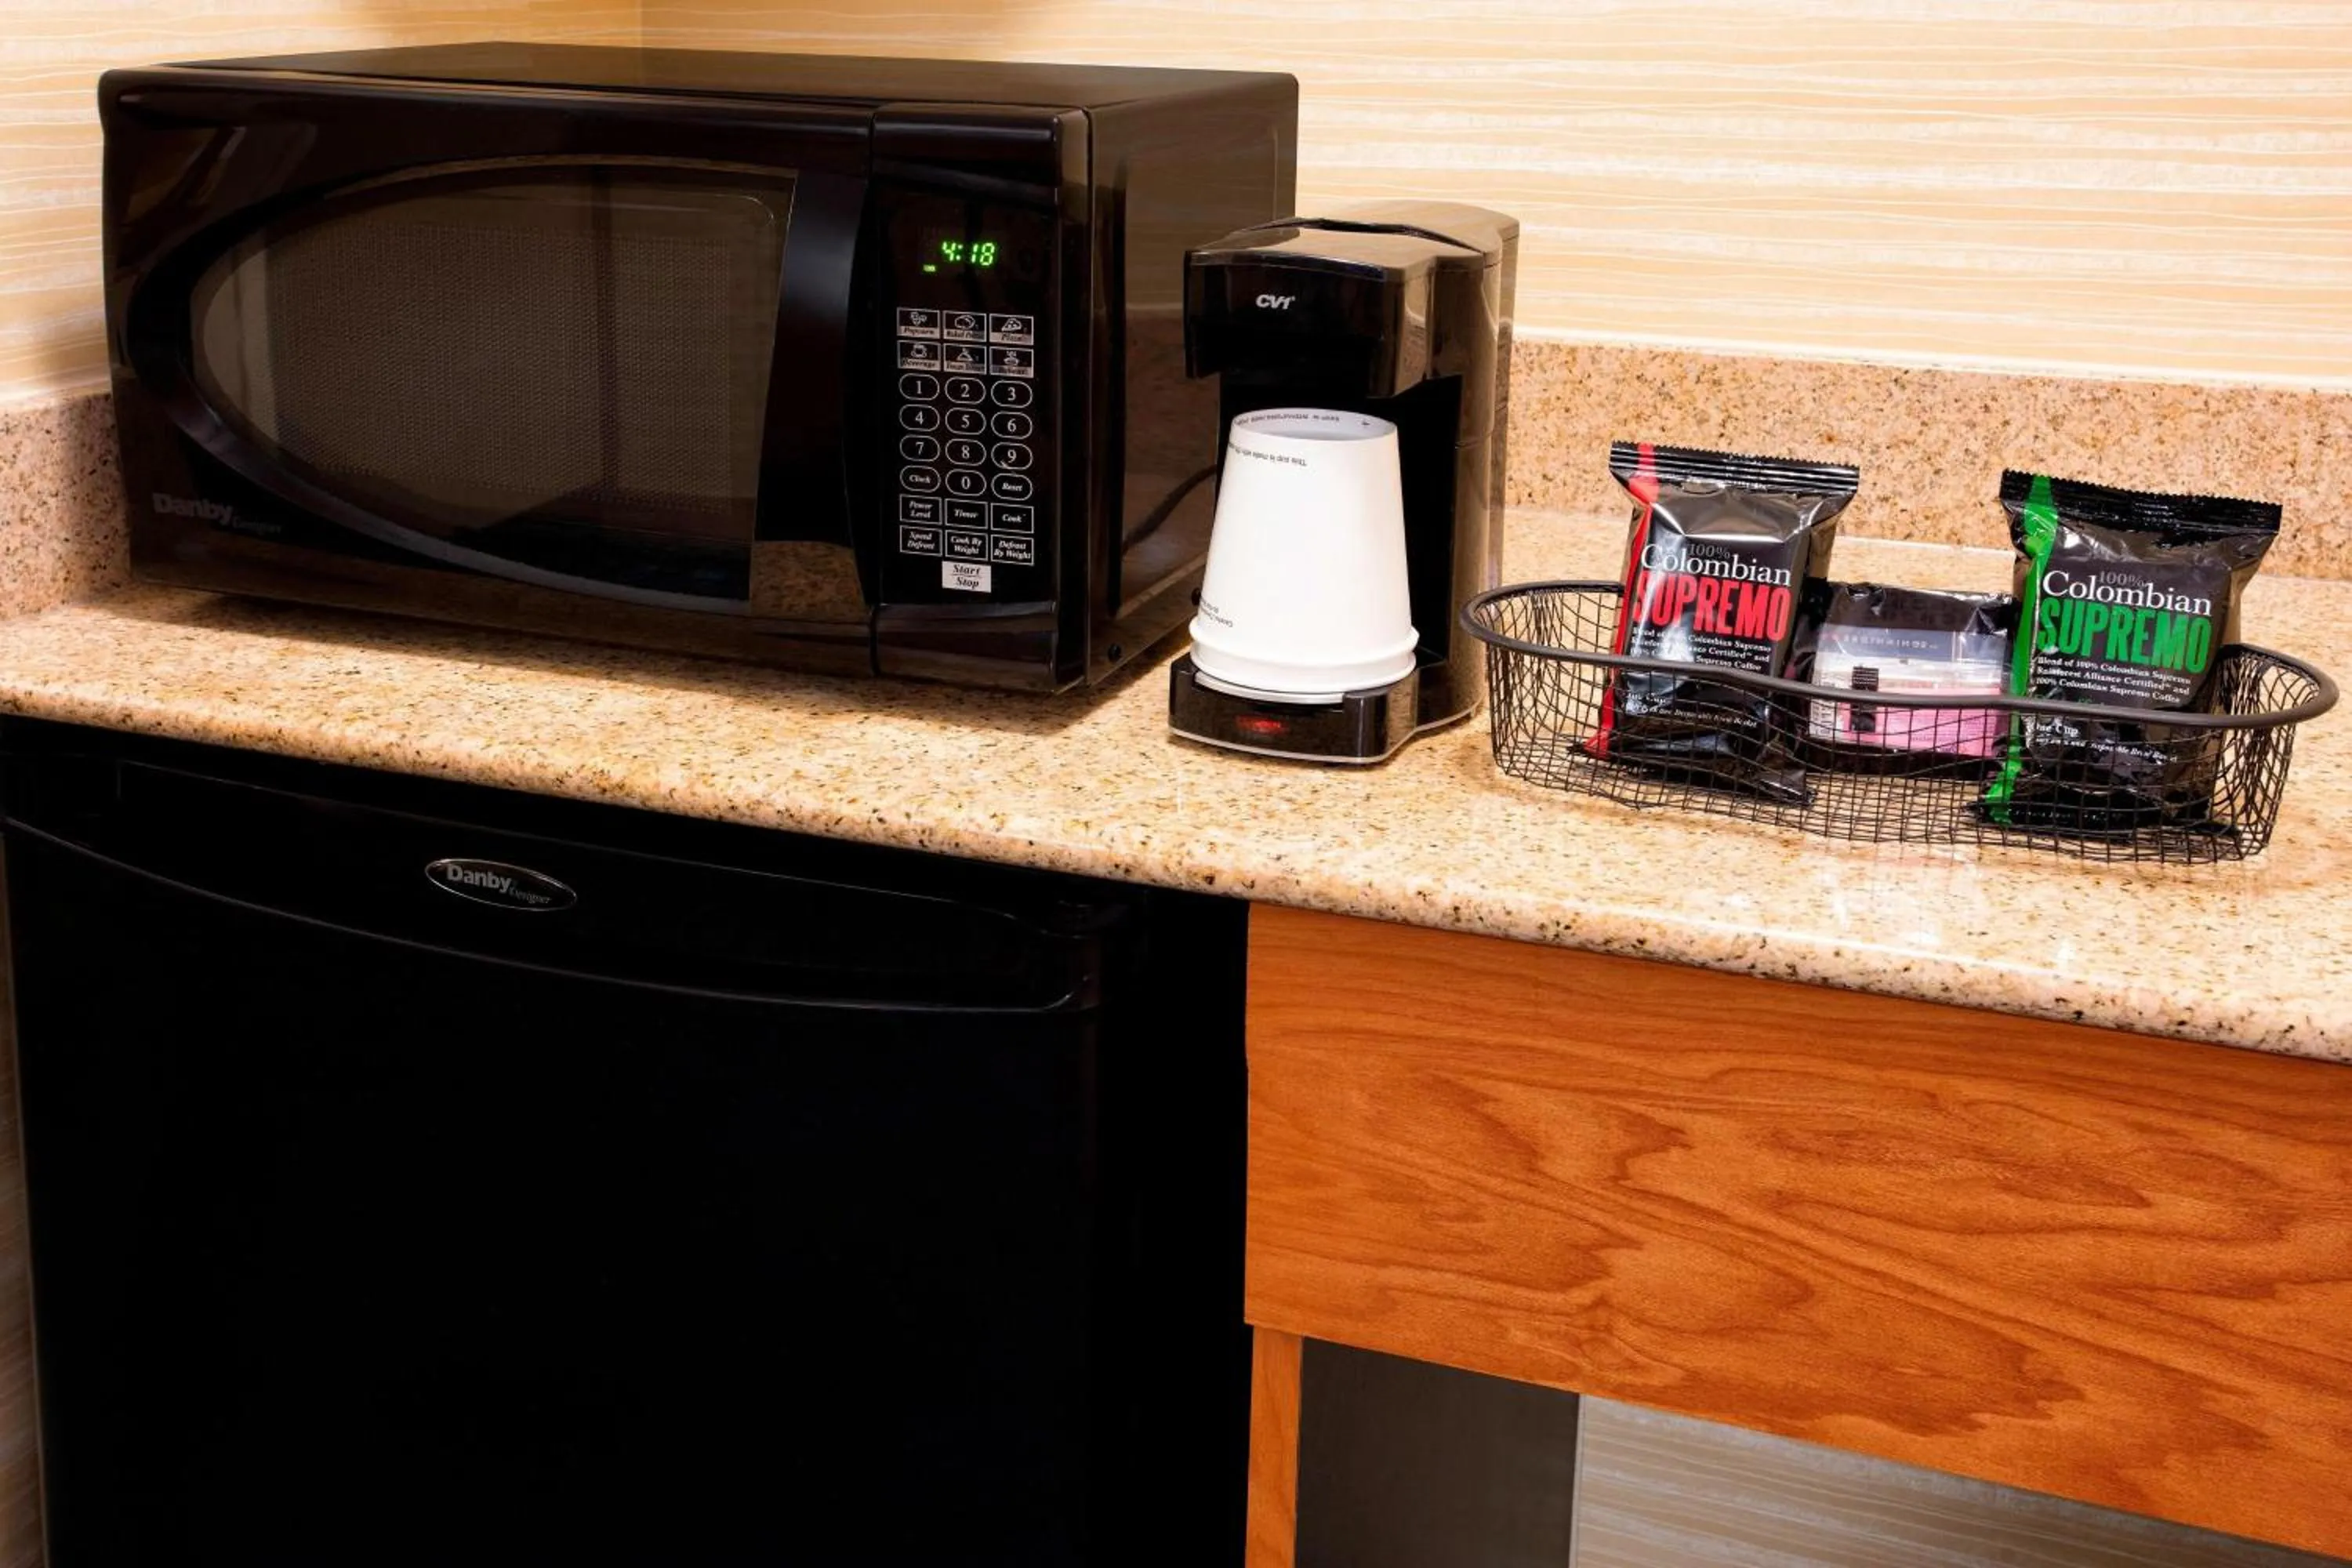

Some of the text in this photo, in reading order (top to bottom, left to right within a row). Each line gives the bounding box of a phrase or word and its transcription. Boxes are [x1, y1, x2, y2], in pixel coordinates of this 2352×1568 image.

[942, 241, 995, 266] 4:18
[916, 380, 1017, 401] 1 2 3
[915, 411, 1017, 432] 4 5 6
[915, 441, 1017, 463] 7 8 9
[909, 474, 931, 484] Clock
[961, 476, 971, 490] 0
[1001, 482, 1023, 492] Reset
[152, 492, 234, 525] Danby
[909, 500, 933, 510] Power
[910, 509, 931, 518] Level
[954, 510, 978, 518] Timer
[1001, 514, 1022, 523] Cook
[909, 531, 932, 541] Speed
[950, 535, 982, 546] Cook By
[907, 540, 935, 550] Defrost
[954, 544, 979, 555] Weight
[999, 539, 1026, 550] Defrost
[1689, 543, 1730, 558] 100%
[993, 549, 1032, 561] By Weight
[953, 564, 980, 575] Start
[1641, 543, 1791, 586] Colombian
[956, 576, 979, 589] Stop
[2100, 570, 2147, 587] 100%
[2042, 570, 2212, 616] Colombian
[1632, 569, 1792, 642] SUPREMO
[2038, 597, 2212, 674] SUPREMO
[2038, 656, 2063, 666] Blend
[2100, 663, 2150, 677] Colombian
[2038, 666, 2082, 678] Rainforest
[2083, 672, 2122, 684] Alliance
[2172, 686, 2190, 695] and
[2059, 678, 2108, 691] Colombian
[2152, 691, 2181, 703] Coffee
[447, 864, 512, 893] Danby
